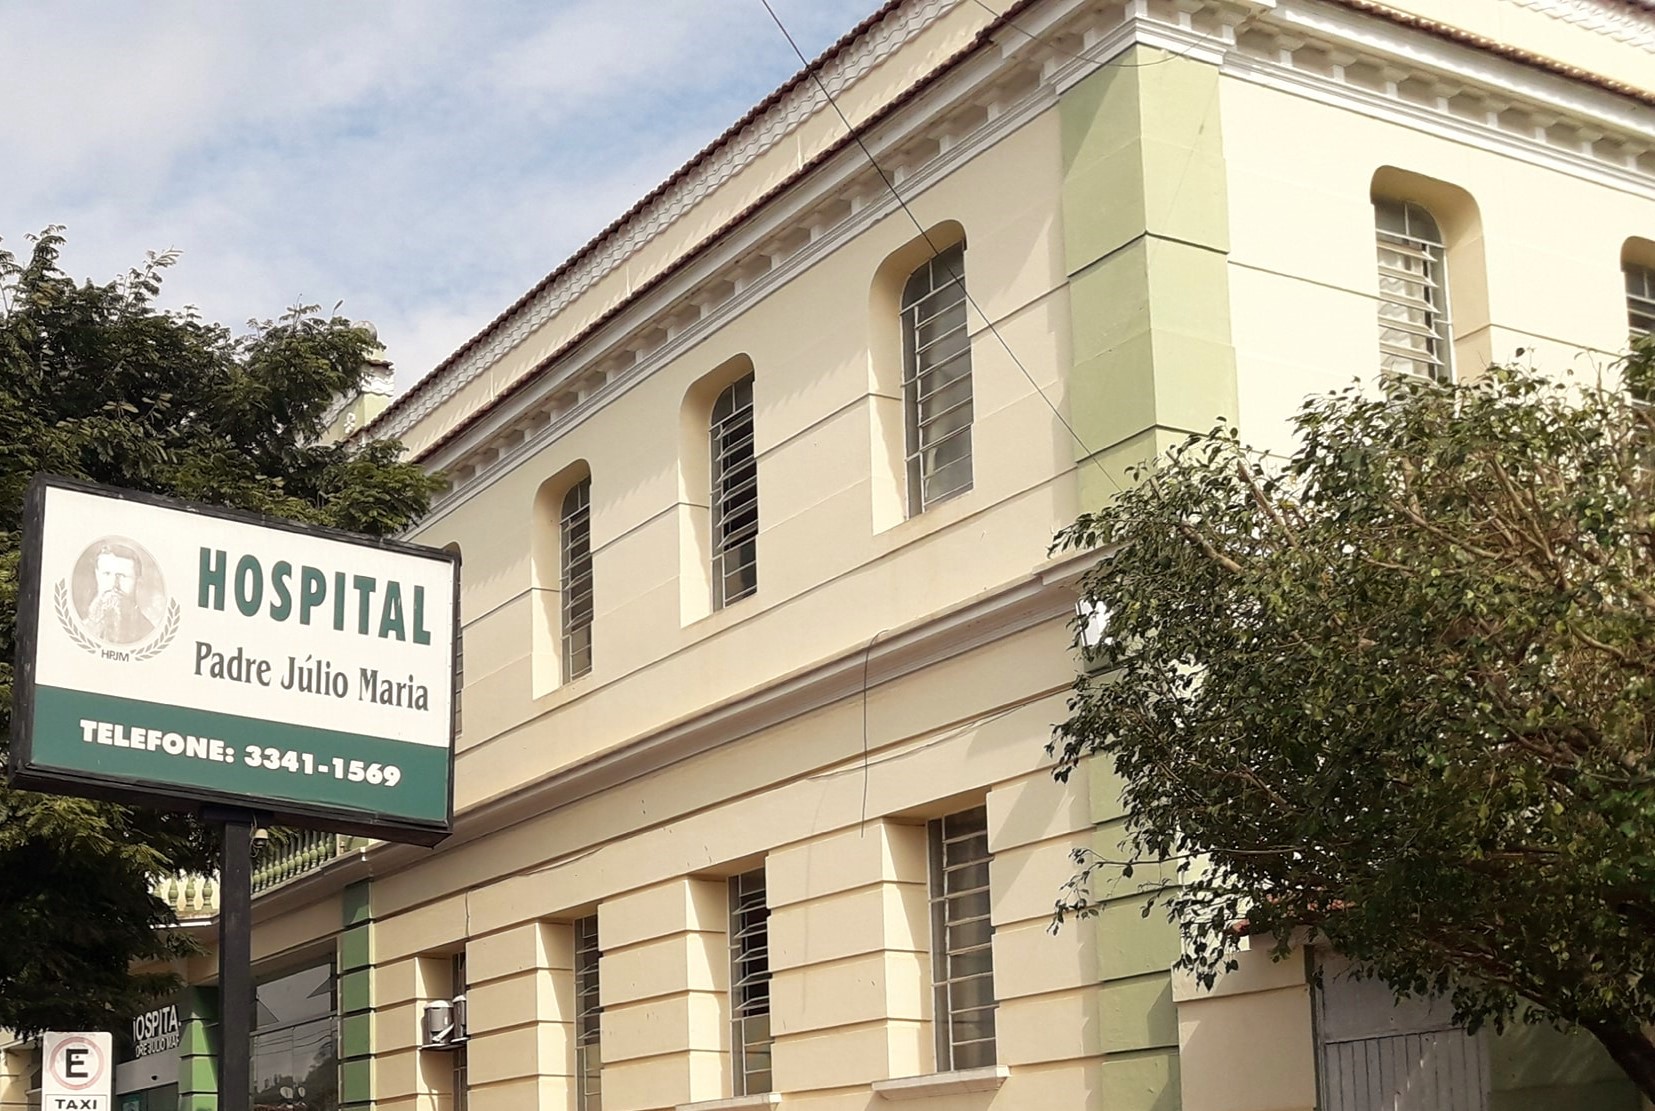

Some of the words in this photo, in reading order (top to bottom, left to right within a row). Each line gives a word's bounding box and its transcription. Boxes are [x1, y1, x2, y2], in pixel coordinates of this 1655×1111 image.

[198, 546, 432, 646] HOSPITAL
[194, 641, 271, 687] Padre
[280, 653, 348, 699] Júlio
[358, 667, 430, 711] Maria
[80, 718, 235, 763] TELEFONE:
[243, 744, 402, 786] 3341-1569
[133, 1004, 181, 1042] OSPITA
[66, 1048, 88, 1078] E
[55, 1099, 97, 1110] TAXI
